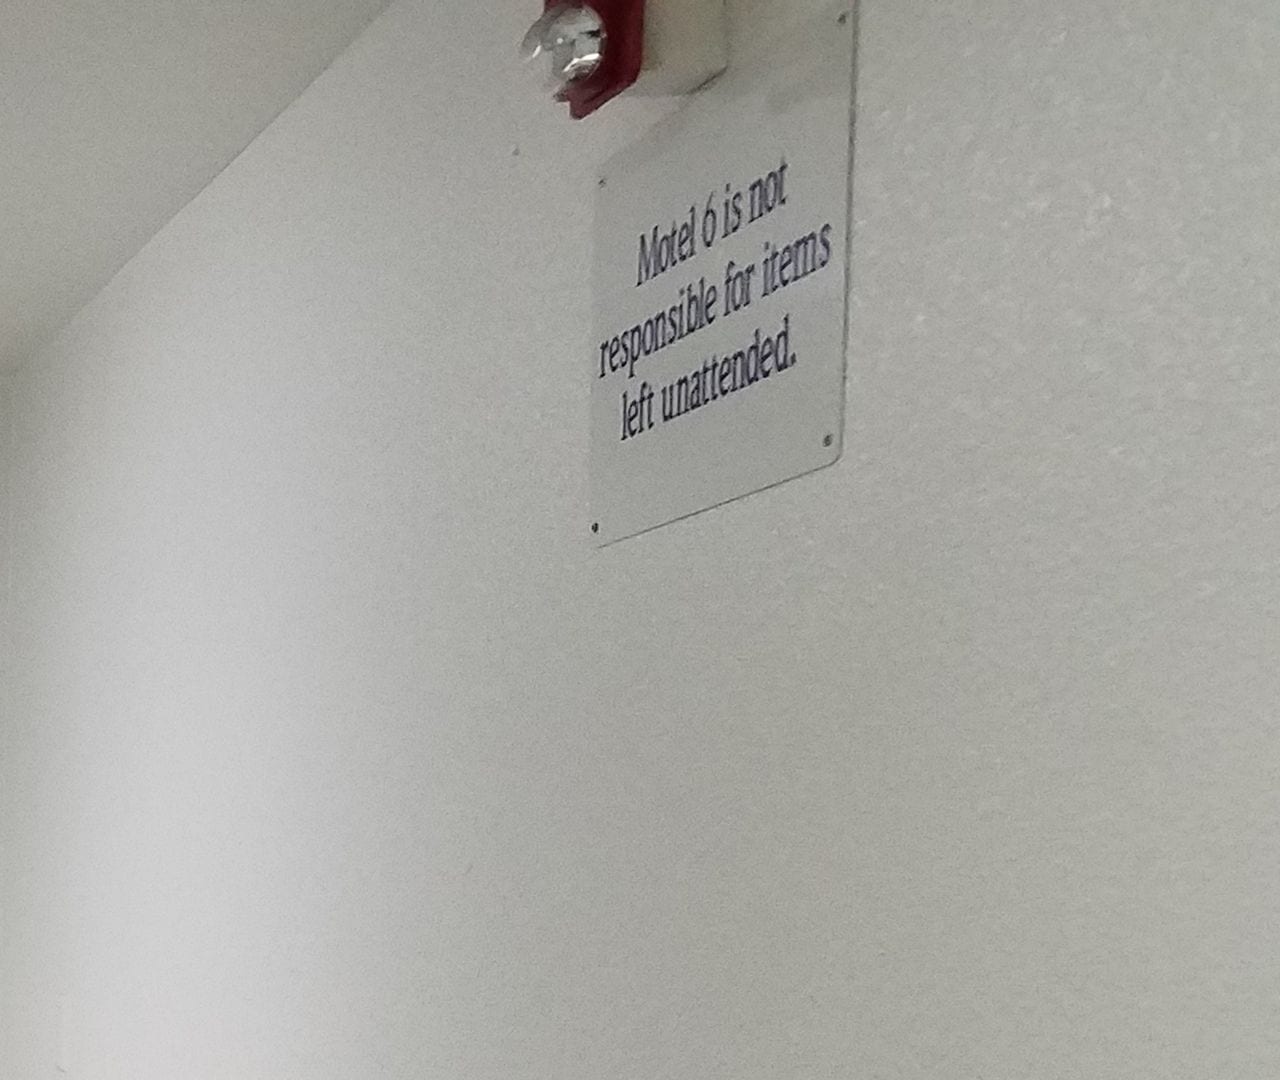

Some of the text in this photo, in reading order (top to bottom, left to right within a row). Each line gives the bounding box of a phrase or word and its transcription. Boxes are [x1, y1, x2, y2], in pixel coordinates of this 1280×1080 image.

[635, 159, 788, 287] Motel 6 is not
[598, 223, 833, 379] responsible for items
[620, 313, 797, 441] left unattended.
